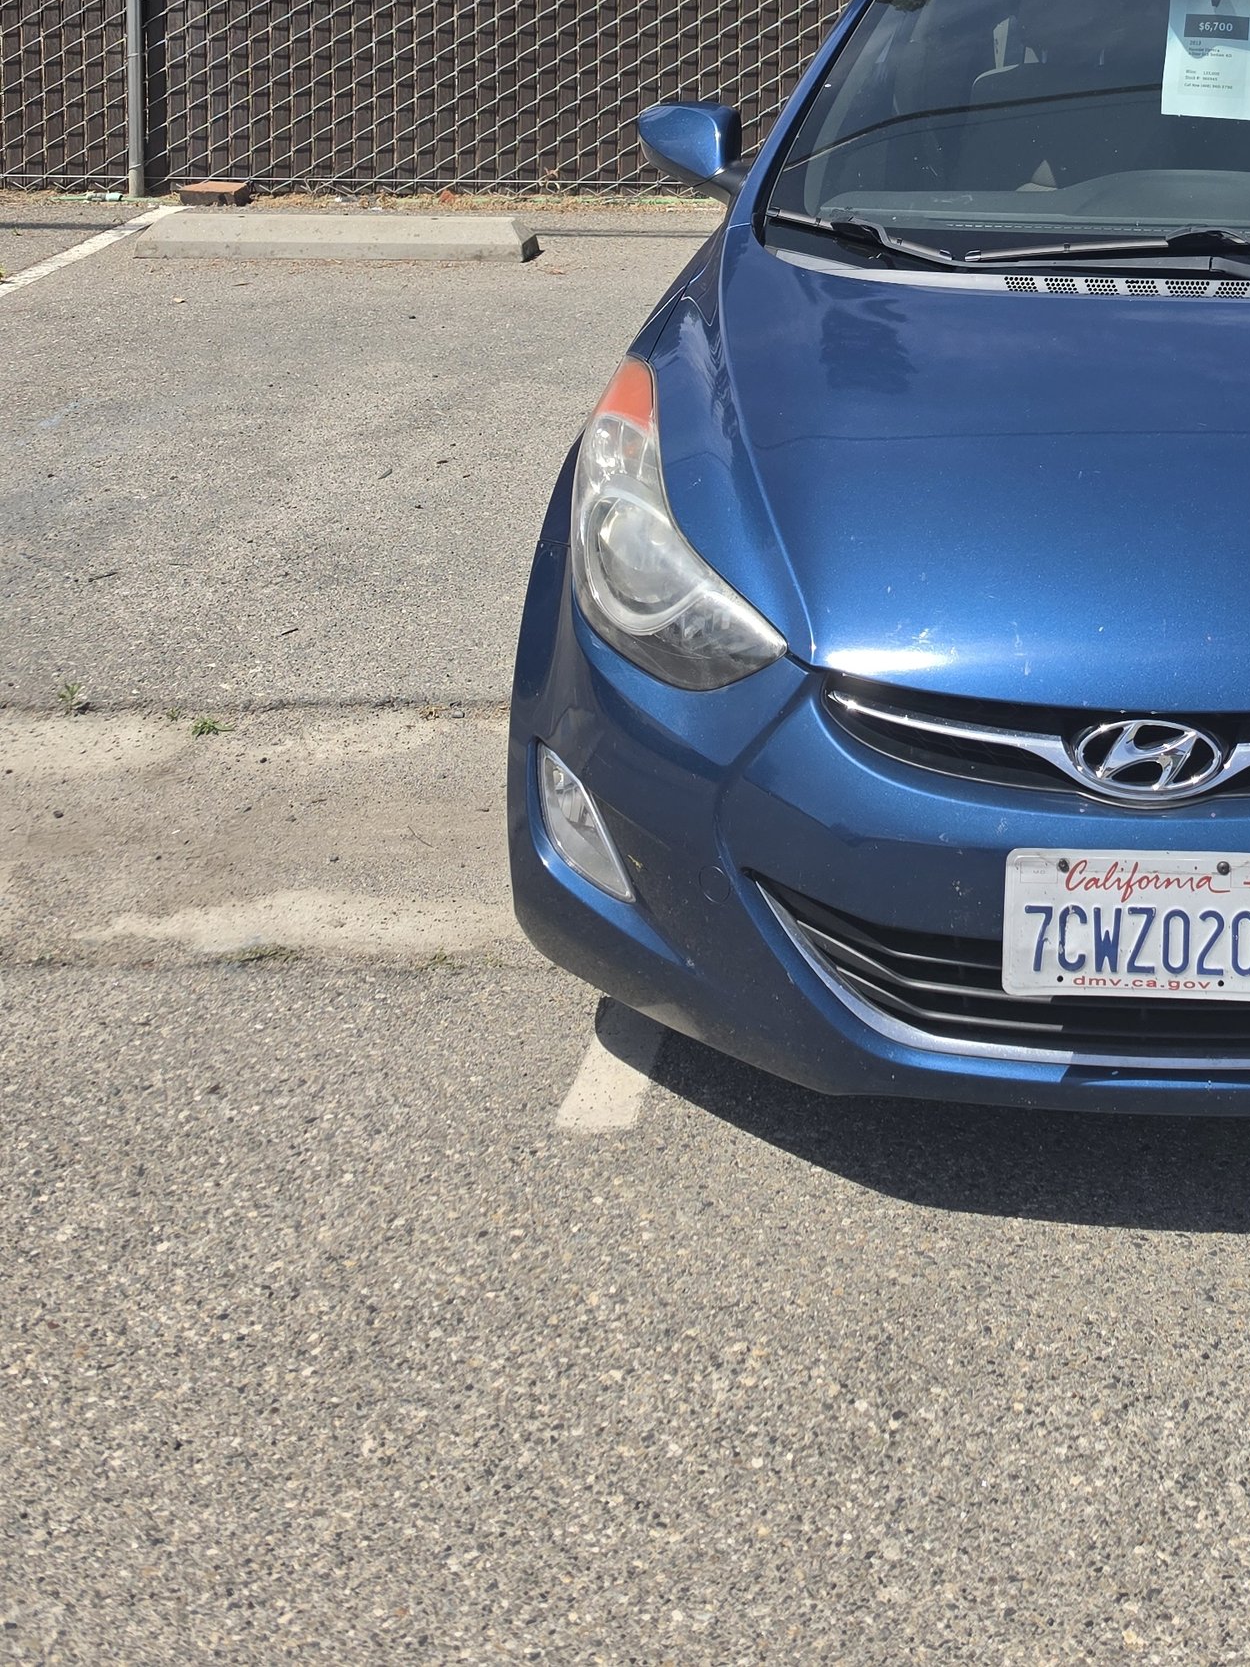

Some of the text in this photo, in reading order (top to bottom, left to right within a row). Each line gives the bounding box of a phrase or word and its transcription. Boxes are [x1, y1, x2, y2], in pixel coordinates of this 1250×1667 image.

[1198, 21, 1233, 33] $6,700
[1065, 859, 1231, 903] California
[1073, 975, 1211, 991] dmv.ca.gov
